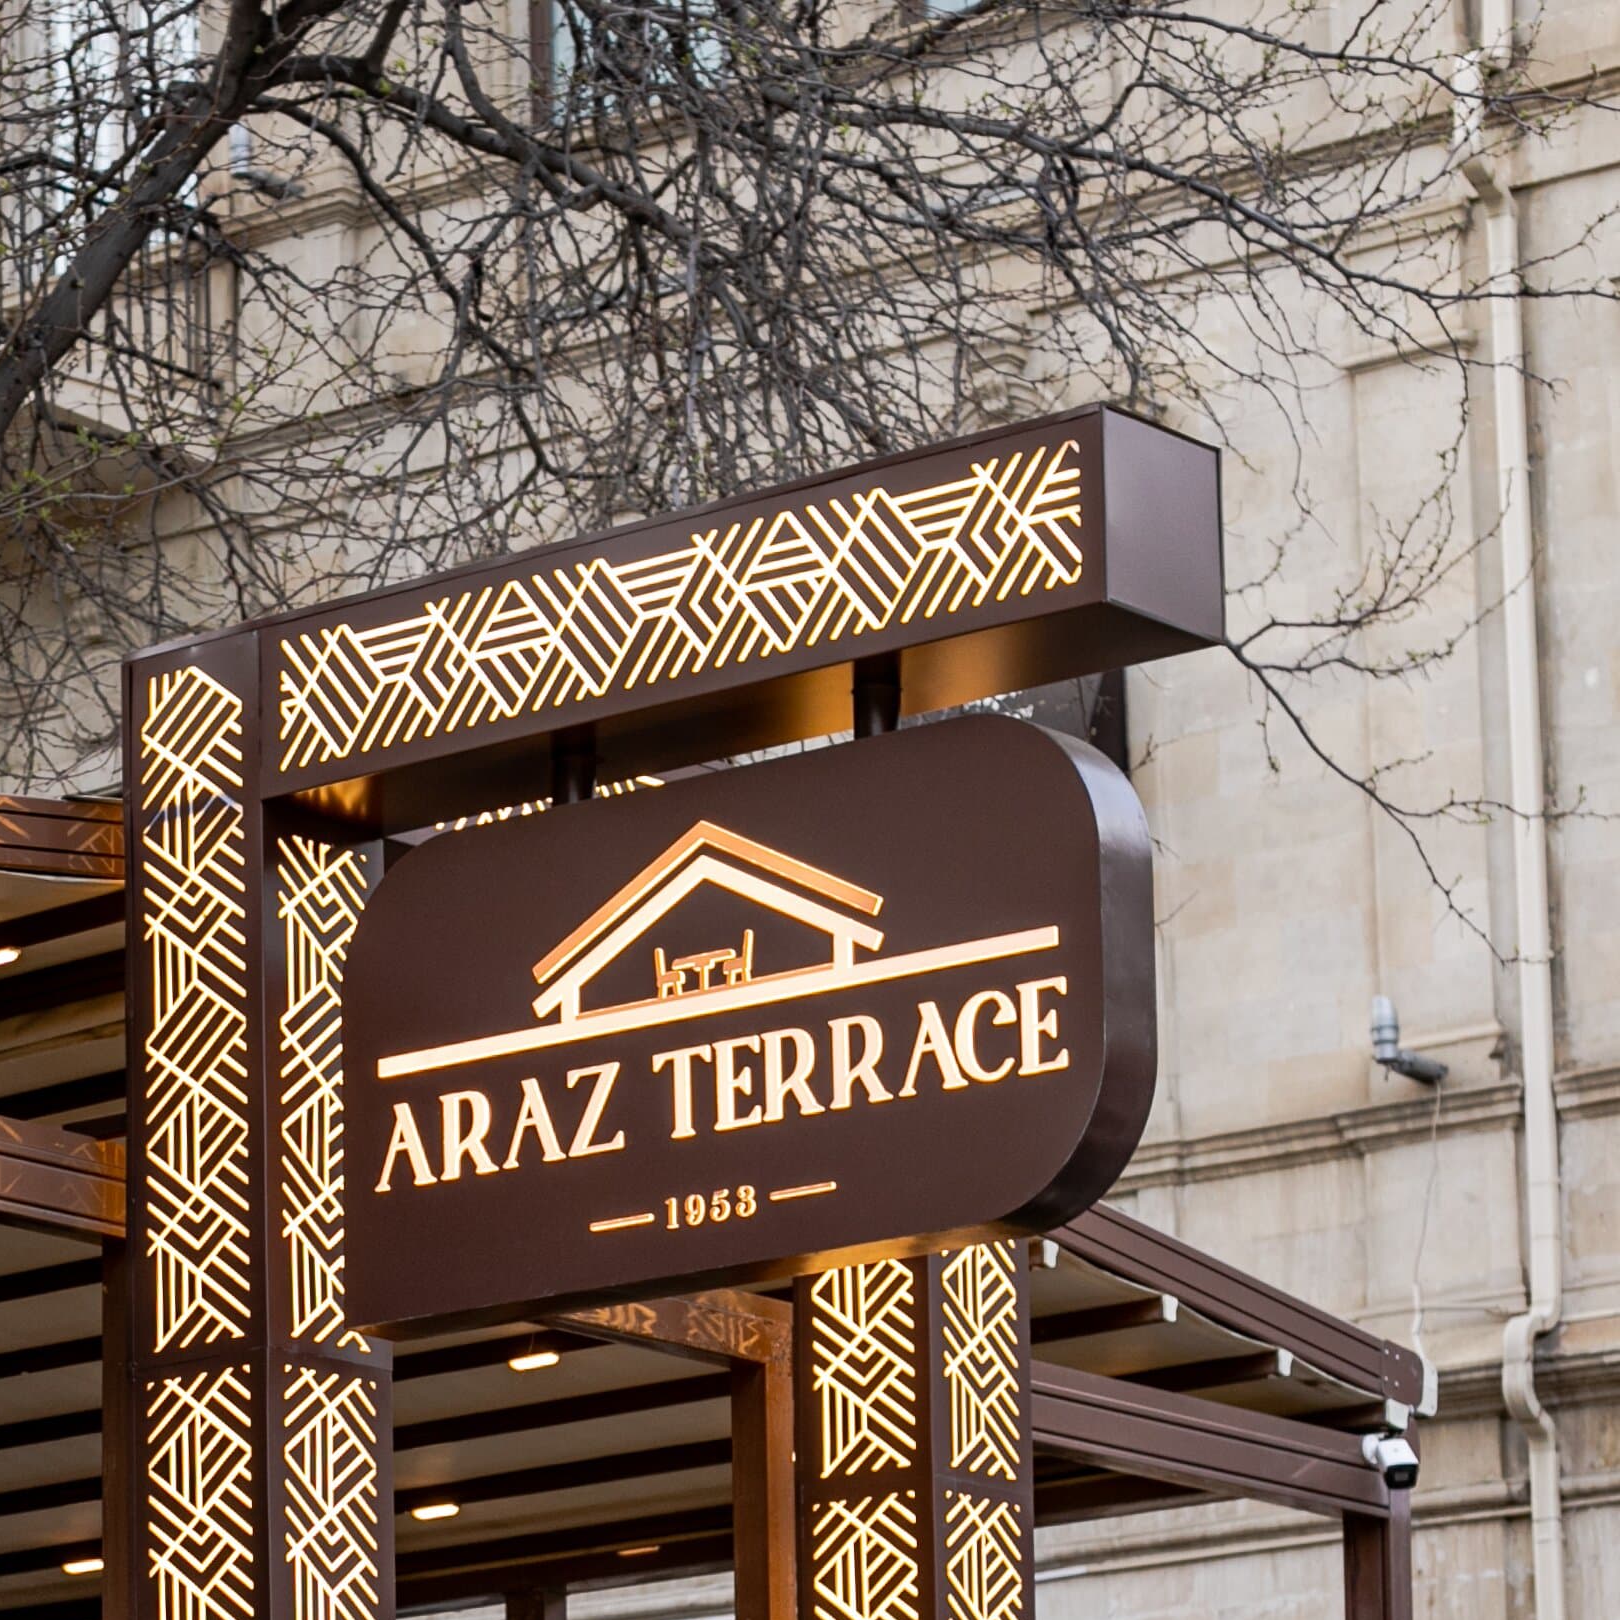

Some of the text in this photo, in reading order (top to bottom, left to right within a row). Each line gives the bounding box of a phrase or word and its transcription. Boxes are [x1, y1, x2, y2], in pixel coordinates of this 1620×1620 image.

[374, 976, 1070, 1193] ARAZ TERRACE
[664, 1184, 757, 1230] 1953
